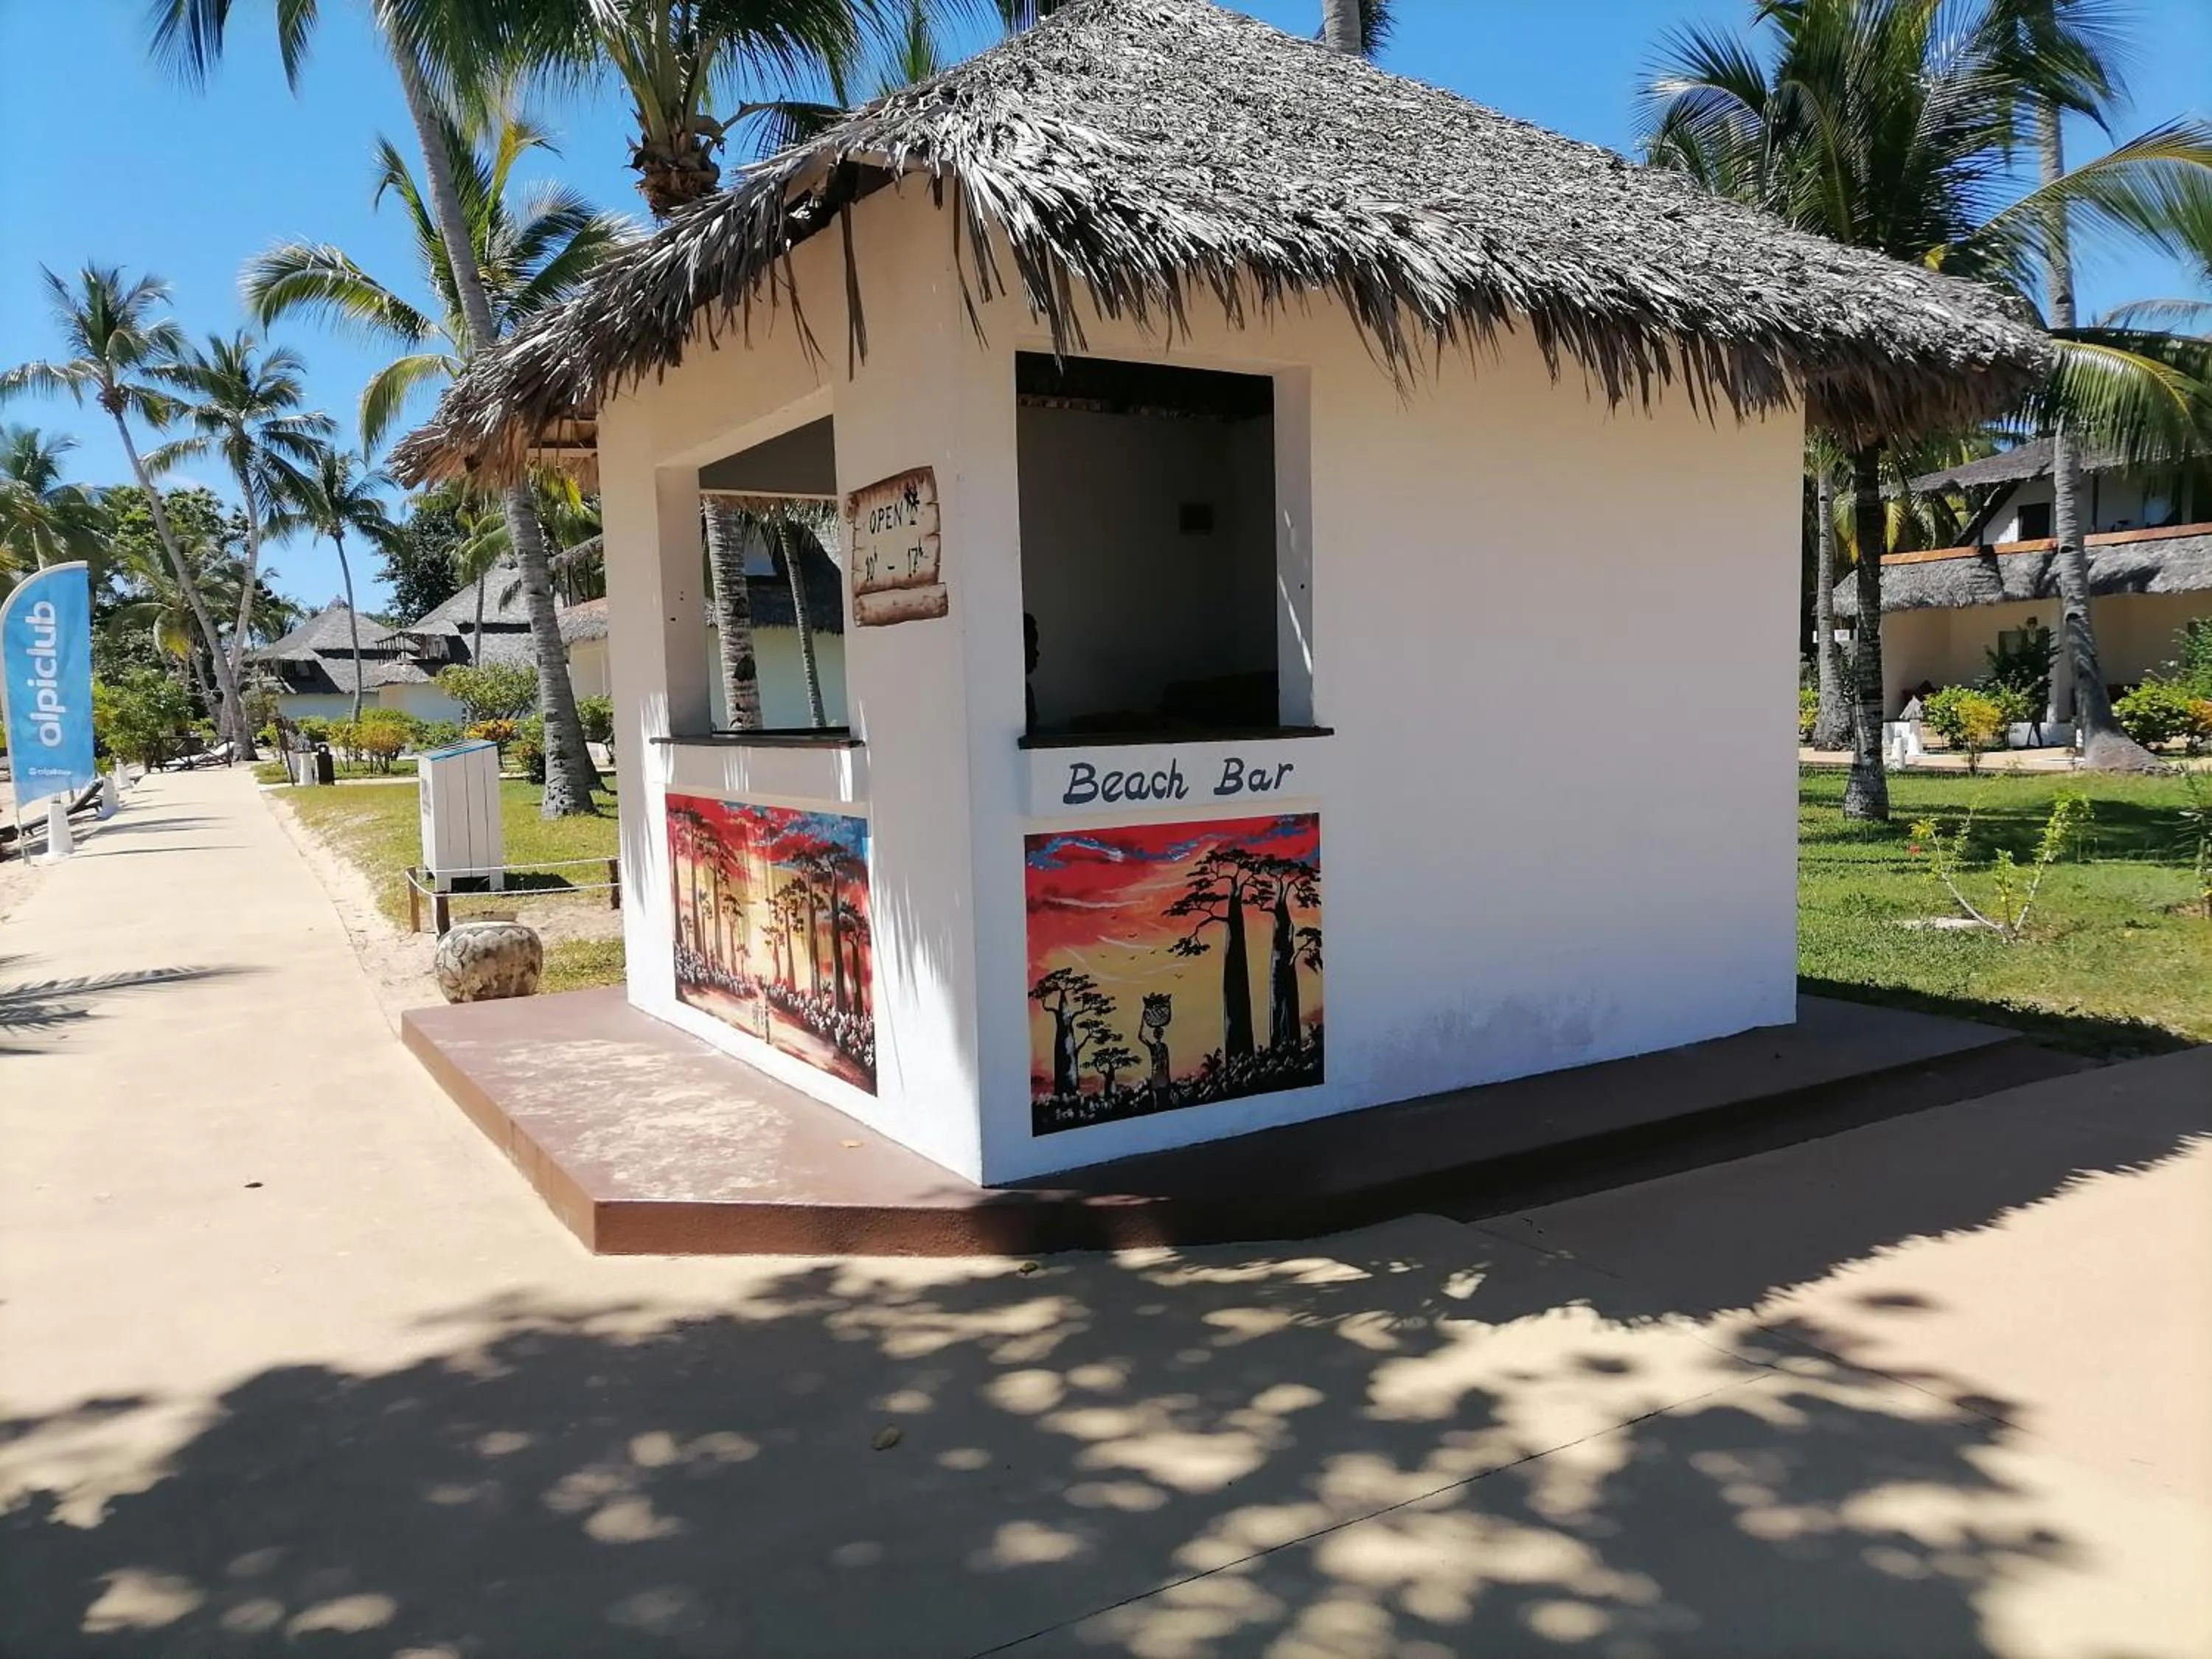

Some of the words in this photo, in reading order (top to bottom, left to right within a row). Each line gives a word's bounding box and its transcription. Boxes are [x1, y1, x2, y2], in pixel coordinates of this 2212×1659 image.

[869, 501, 902, 535] OPEN
[25, 601, 66, 747] alpiclub
[1062, 758, 1189, 804] Beach
[1214, 757, 1293, 796] Bar
